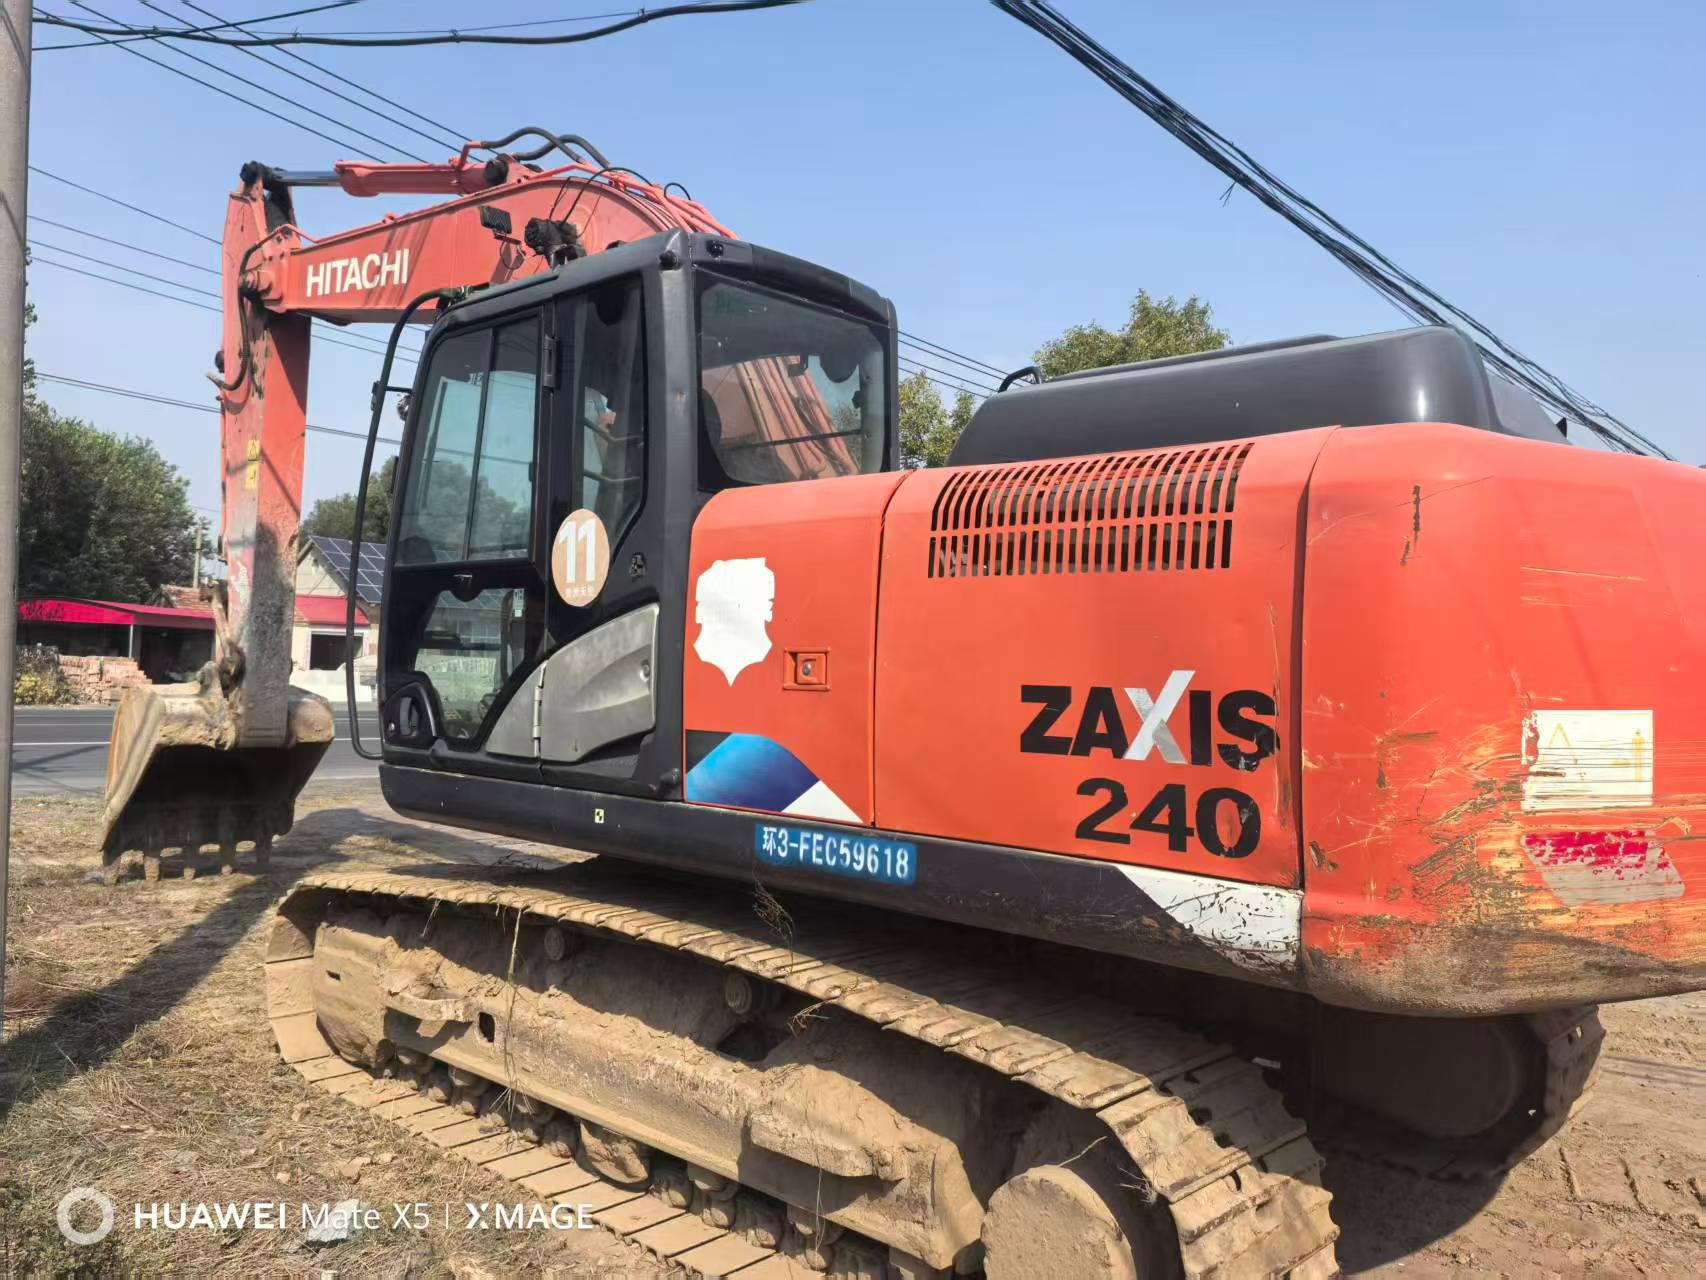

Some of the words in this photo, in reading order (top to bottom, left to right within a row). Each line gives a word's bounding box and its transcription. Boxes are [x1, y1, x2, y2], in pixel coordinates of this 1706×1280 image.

[306, 248, 409, 297] HITACHI
[559, 518, 595, 583] 11
[1020, 669, 1280, 772] ZAXIS
[1075, 777, 1262, 858] 240
[763, 826, 909, 878] 环3-FEC59618
